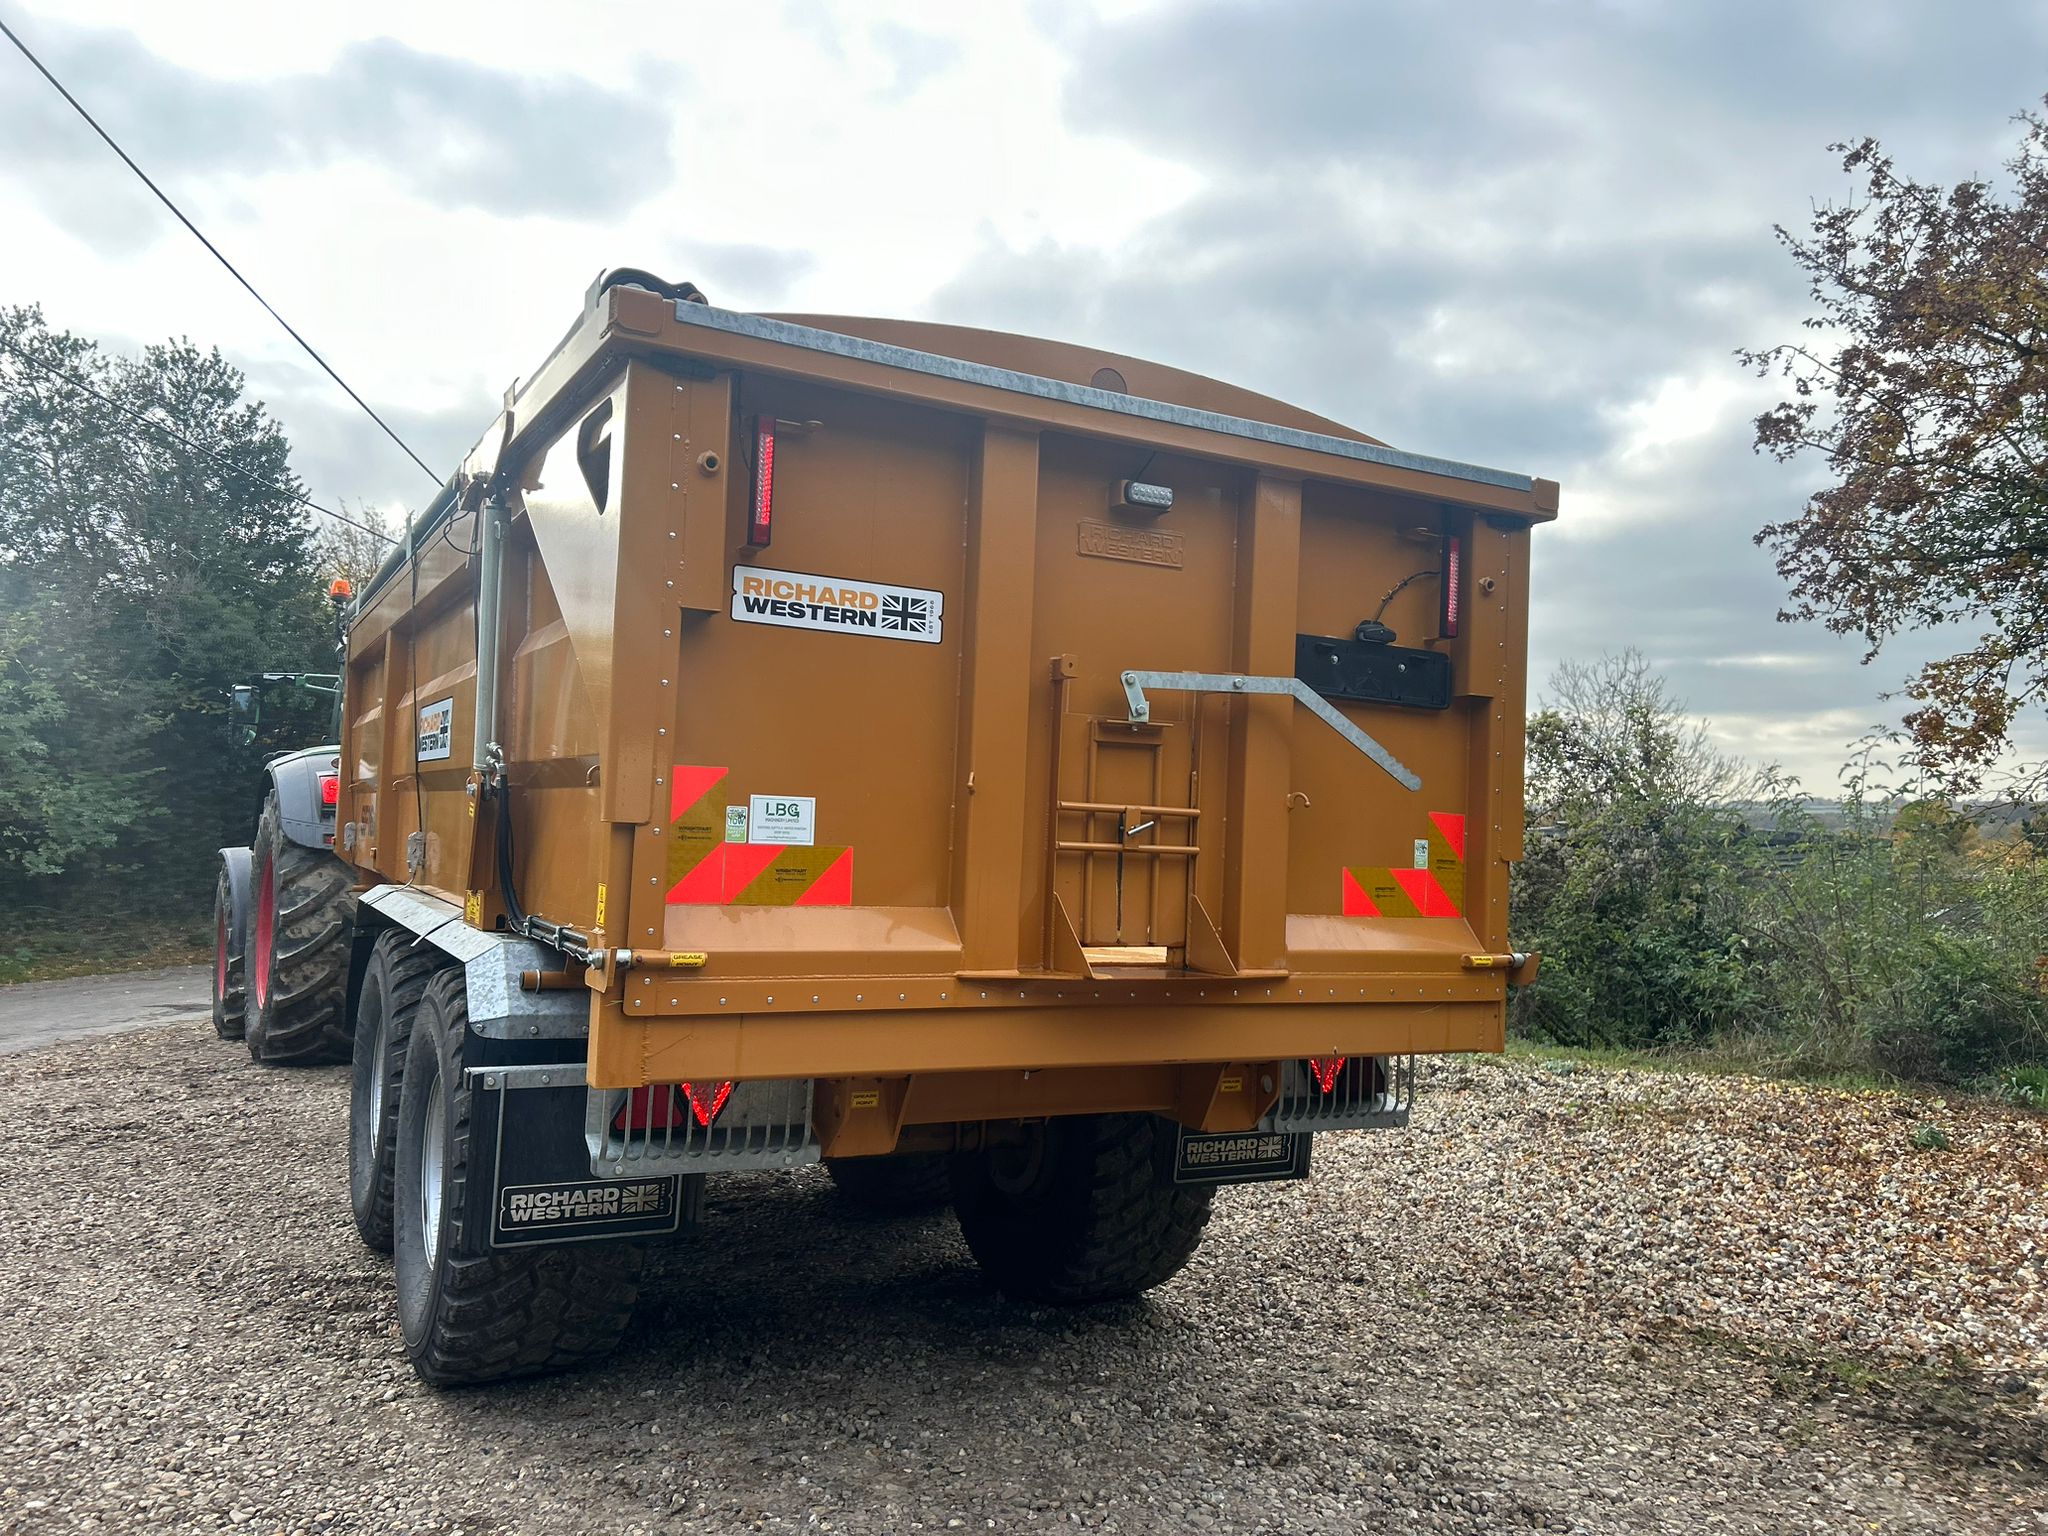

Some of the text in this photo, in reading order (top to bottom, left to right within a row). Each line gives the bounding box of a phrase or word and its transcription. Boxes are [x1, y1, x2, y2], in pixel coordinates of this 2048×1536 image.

[1090, 527, 1174, 550] RICHARD
[1085, 539, 1179, 564] WESTERN
[743, 576, 878, 610] RICHARD
[743, 596, 877, 627] WESTERN
[765, 802, 800, 818] LBG
[1187, 1138, 1258, 1154] RICHARD
[1187, 1149, 1256, 1164] WESTERN
[510, 1187, 620, 1209] RICHARD
[510, 1201, 618, 1222] WESTERN
